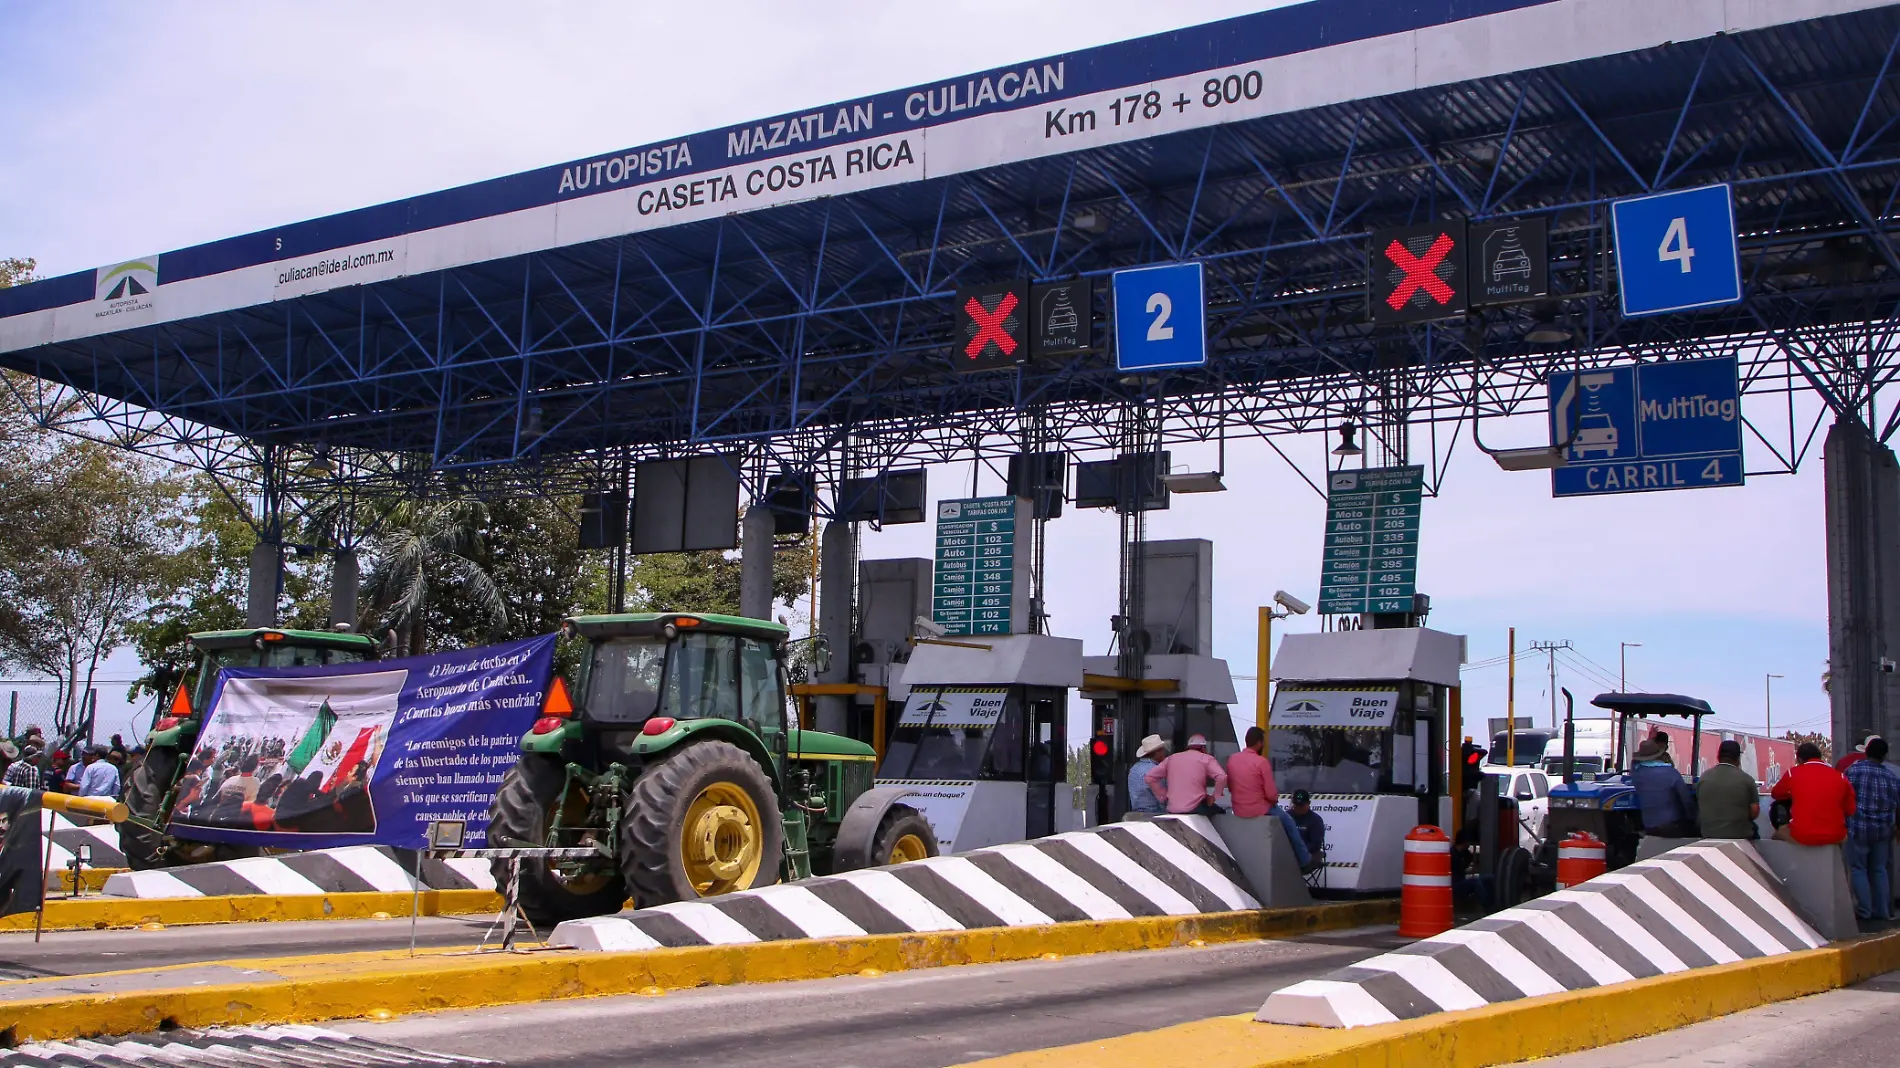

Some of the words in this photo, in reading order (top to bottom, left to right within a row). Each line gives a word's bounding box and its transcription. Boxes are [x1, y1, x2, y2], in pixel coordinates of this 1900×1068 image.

[1045, 108, 1097, 139] Km
[1108, 90, 1162, 126] 178
[1172, 92, 1191, 113] +
[1202, 70, 1263, 108] 800
[558, 142, 693, 194] AUTOPISTA
[727, 102, 873, 159] MAZATLAN
[904, 61, 1065, 121] CULIACAN
[637, 174, 738, 216] CASETA
[746, 154, 837, 196] COSTA
[846, 139, 915, 177] RICA
[1658, 217, 1695, 274] 4
[278, 249, 395, 285] culiacan@ideal.com.mx
[1487, 283, 1530, 295] MultiTag
[110, 299, 138, 308] AUTOPISTA
[1145, 292, 1174, 341] 2
[1043, 336, 1076, 347] MultiTag
[1641, 394, 1735, 422] MultiTag
[1586, 462, 1685, 489] CARRIL
[1701, 459, 1723, 482] 4
[1385, 508, 1405, 516] 102
[990, 522, 998, 532] $
[1335, 522, 1362, 531] Auto
[1384, 520, 1405, 529] 205
[943, 538, 967, 546] Moto
[984, 535, 1002, 543] 102
[1383, 533, 1404, 541] 335
[943, 549, 965, 558] Auto
[984, 547, 1002, 555] 205
[1382, 547, 1403, 556] 348
[943, 561, 967, 569] Autobus
[983, 560, 1001, 568] 335
[1381, 560, 1402, 569] 395
[983, 572, 1001, 580] 348
[1380, 574, 1401, 582] 495
[983, 585, 1001, 593] 395
[1379, 587, 1400, 596] 102
[982, 598, 1000, 606] 495
[1378, 601, 1399, 610] 174
[981, 611, 999, 619] 102
[981, 624, 999, 632] 174
[440, 663, 467, 677] Horas
[467, 660, 479, 672] de
[416, 682, 467, 700] Aeropuerto
[468, 679, 480, 693] de
[444, 702, 467, 716] horas
[468, 697, 492, 711] más
[495, 691, 542, 709] vendrán?
[973, 698, 1002, 707] Buen
[1351, 697, 1388, 707] Buen
[969, 708, 998, 719] Viaje
[1349, 708, 1385, 720] Viaje
[421, 737, 467, 752] enemigos
[469, 735, 480, 747] de
[481, 735, 489, 746] la
[490, 733, 513, 749] patria
[513, 735, 519, 748] y
[394, 758, 404, 769] de
[405, 757, 419, 769] las
[421, 754, 469, 768] libertades
[469, 753, 480, 765] de
[480, 753, 492, 765] los
[493, 751, 520, 768] pueblos
[396, 774, 435, 788] siempre
[437, 773, 451, 784] han
[454, 771, 484, 784] llamado
[403, 795, 409, 803] a
[411, 791, 424, 804] los
[425, 793, 440, 806] que
[441, 793, 450, 803] se
[450, 790, 488, 804] sacrifican
[933, 791, 966, 799] choque?
[1323, 804, 1358, 813] choque?
[415, 812, 441, 821] causas
[442, 809, 467, 821] nobles
[467, 809, 477, 821] de
[464, 829, 486, 843] apata
